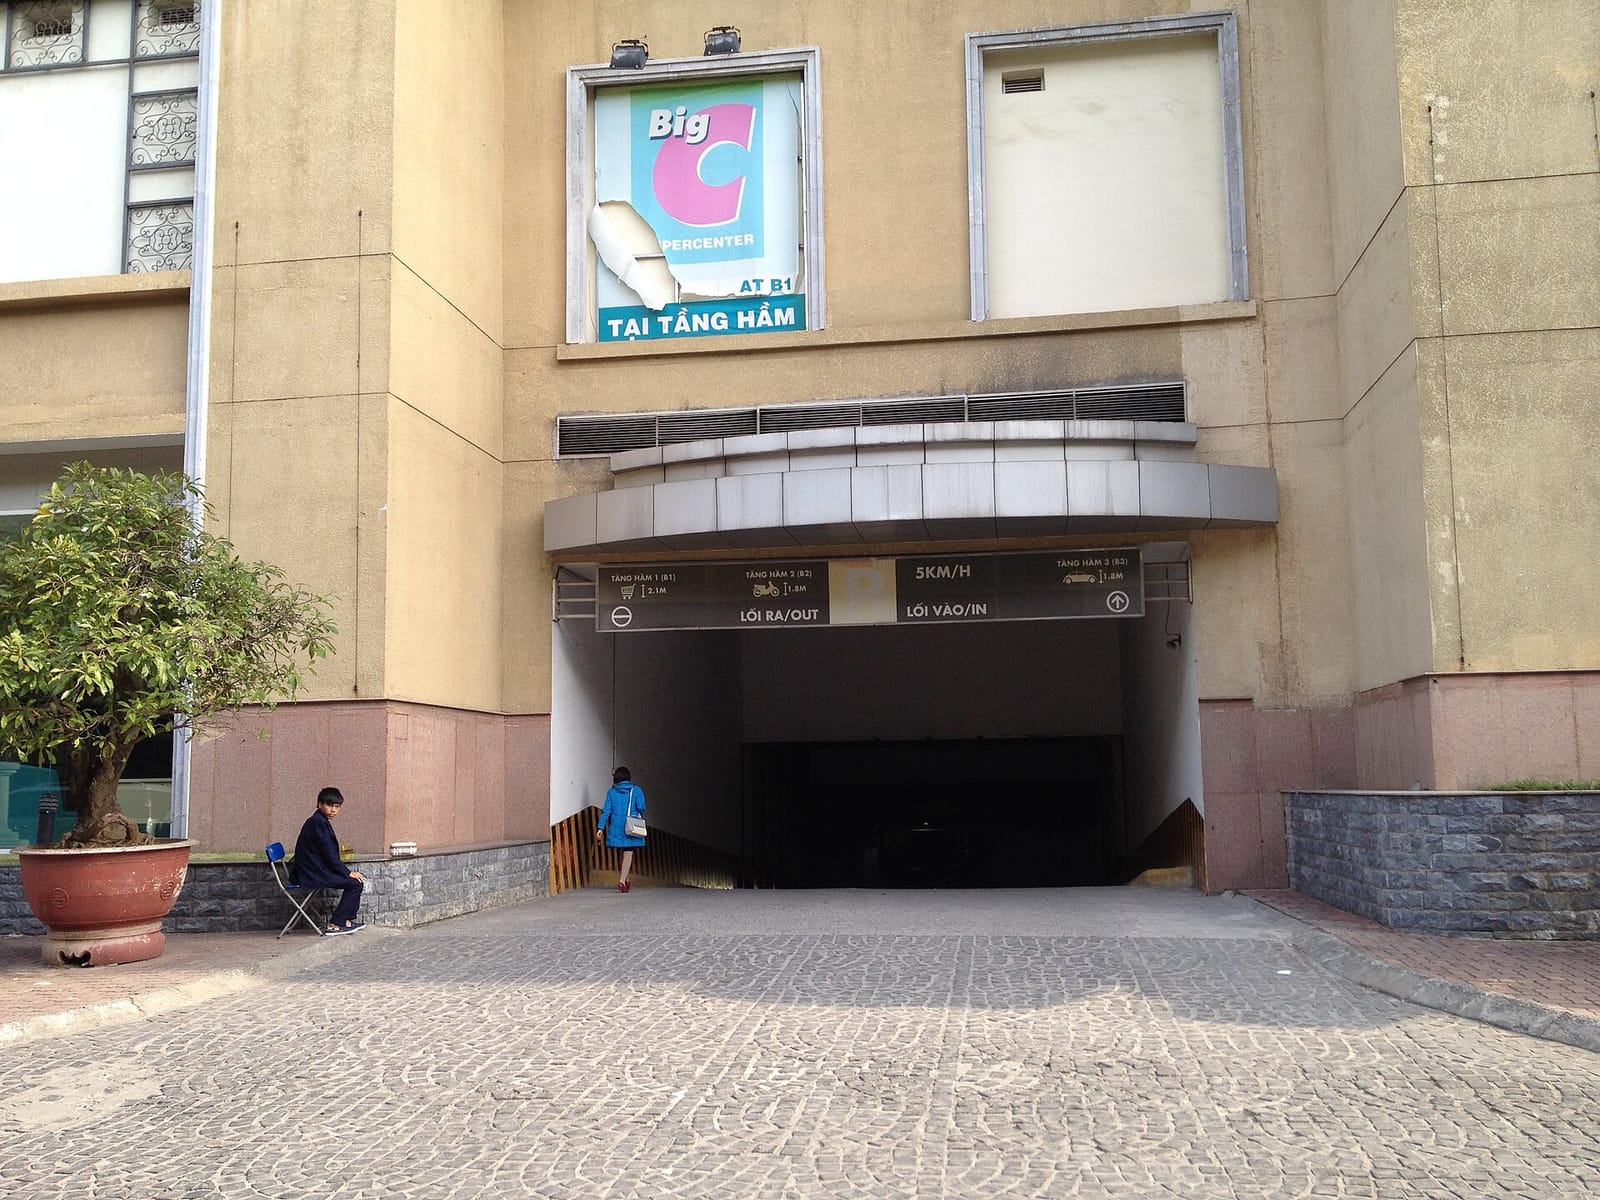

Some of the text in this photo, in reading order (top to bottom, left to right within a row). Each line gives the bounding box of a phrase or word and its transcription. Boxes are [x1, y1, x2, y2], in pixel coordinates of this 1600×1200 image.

[649, 106, 711, 144] Big
[653, 103, 757, 228] C
[659, 233, 754, 250] PERCENTER
[740, 277, 792, 293] AT B1
[608, 302, 795, 341] TẠI TẦNG HẦM
[661, 573, 676, 582] (B1)
[797, 569, 812, 579] (B2)
[915, 564, 971, 580] 5KM/H
[647, 586, 667, 595] 2.1M
[740, 607, 819, 622] LỐI RA/OUT
[906, 602, 987, 617] LỐI VÀO/IN
